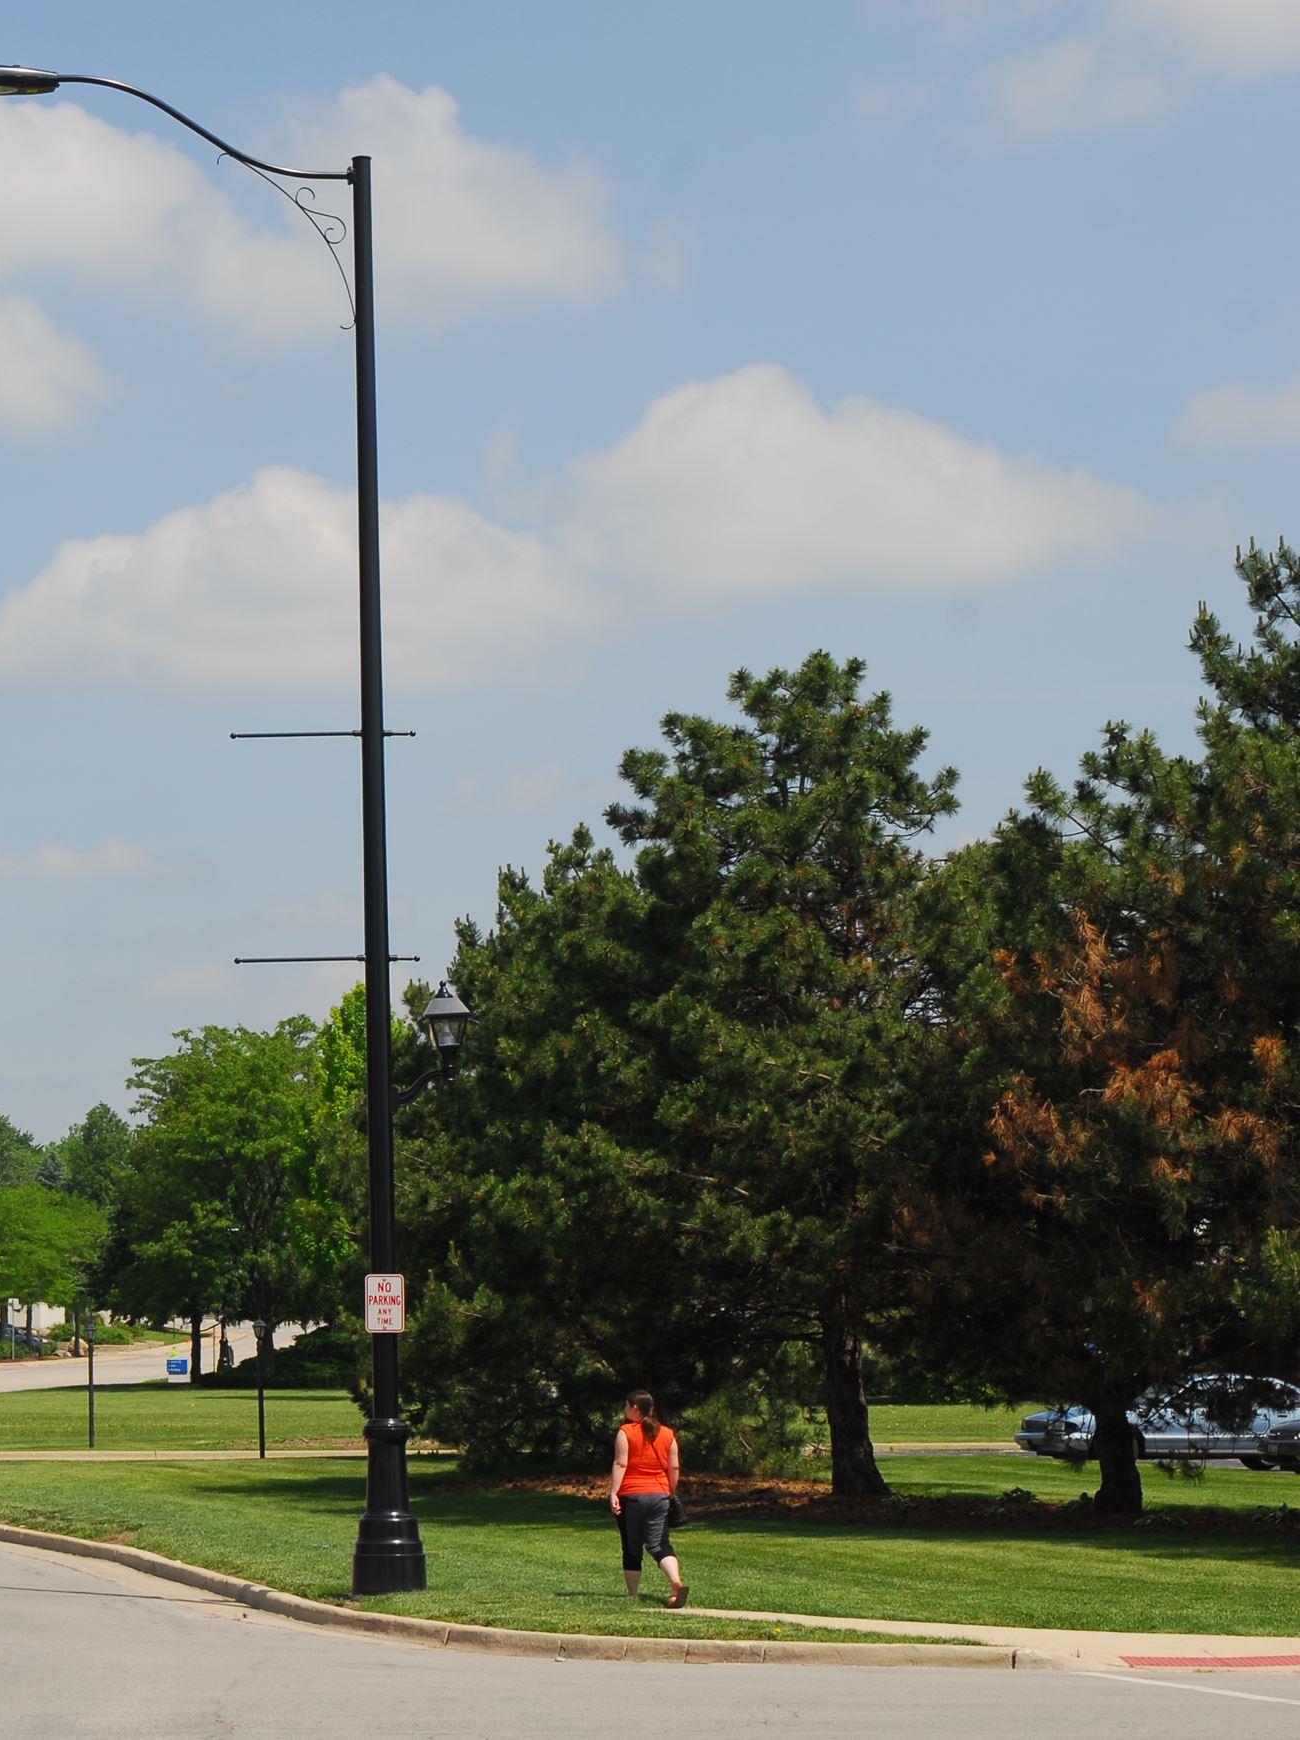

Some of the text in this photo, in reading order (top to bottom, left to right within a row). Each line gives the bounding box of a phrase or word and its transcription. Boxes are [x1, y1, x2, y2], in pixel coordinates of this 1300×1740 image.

[377, 1282, 392, 1293] NO
[368, 1295, 401, 1306] PARKING
[377, 1308, 392, 1316] ANY
[377, 1317, 393, 1325] TIME
